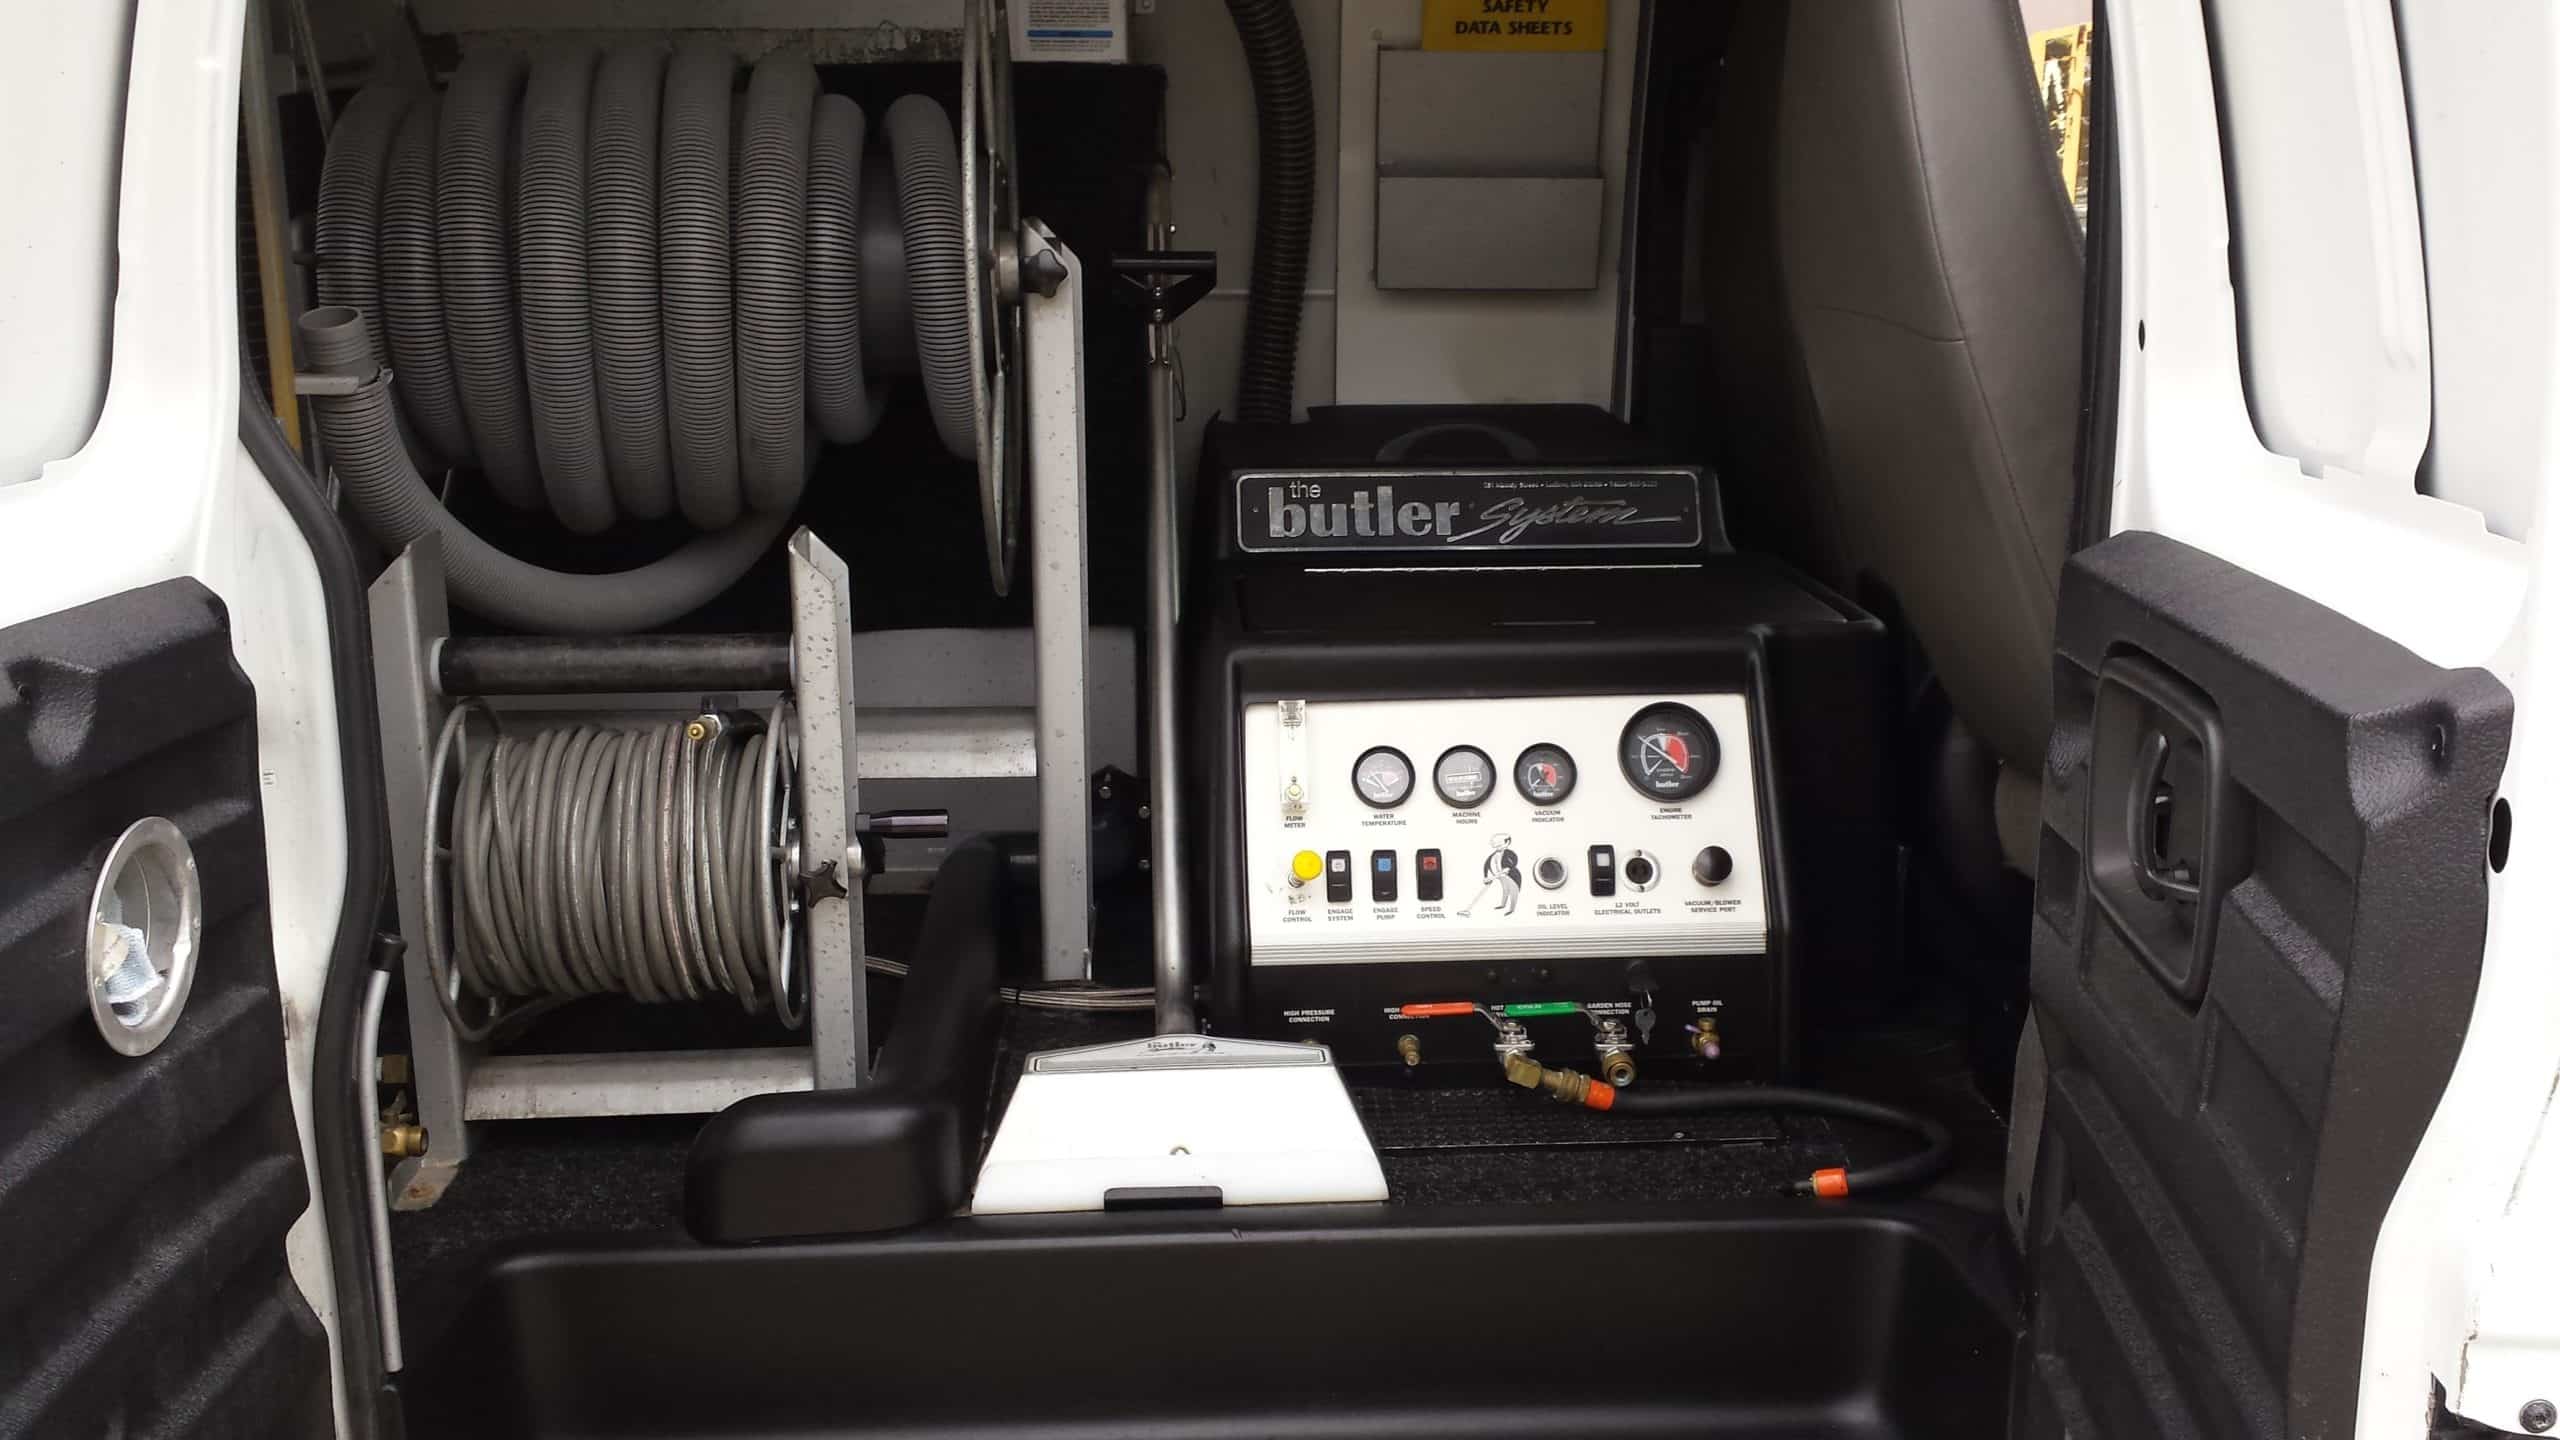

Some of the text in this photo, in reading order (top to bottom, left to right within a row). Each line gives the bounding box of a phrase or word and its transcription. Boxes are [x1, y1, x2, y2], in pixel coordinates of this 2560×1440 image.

[1482, 0, 1550, 13] SAFETY
[1455, 21, 1573, 35] DATA SHEETS
[1289, 481, 1321, 498] the
[1269, 486, 1460, 538] butler
[1447, 496, 1682, 544] System
[1361, 819, 1407, 827] TEMPERATURE
